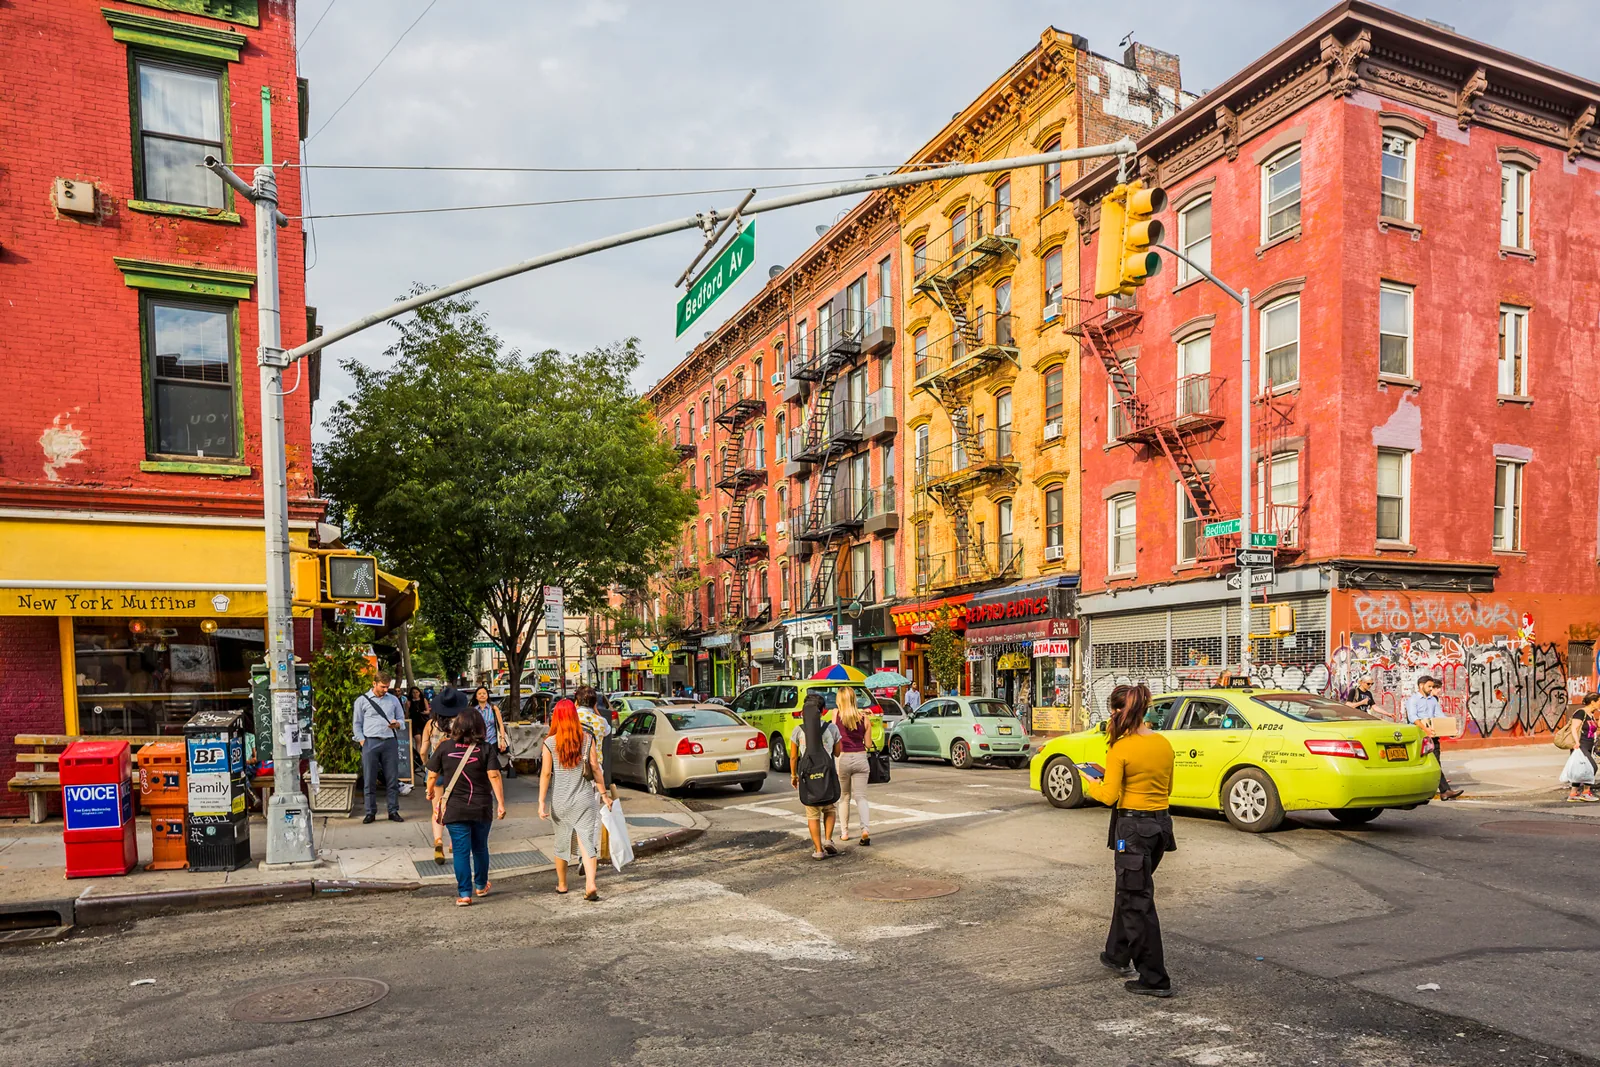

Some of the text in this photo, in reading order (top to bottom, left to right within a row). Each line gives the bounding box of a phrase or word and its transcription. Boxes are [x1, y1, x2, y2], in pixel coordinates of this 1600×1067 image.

[685, 247, 744, 322] Bedford Av
[1205, 522, 1232, 537] Bedford
[1254, 535, 1259, 545] N
[1261, 534, 1266, 545] 6
[1241, 554, 1252, 562] ONE
[1254, 573, 1268, 582] WAY
[18, 594, 196, 611] New York Muffins
[966, 602, 1004, 623] BEDFORD
[1006, 596, 1047, 618] EXOTICS
[1034, 643, 1049, 654] ATM
[1050, 644, 1068, 654] ATM
[71, 786, 115, 801] VOICE
[189, 782, 229, 796] Family
